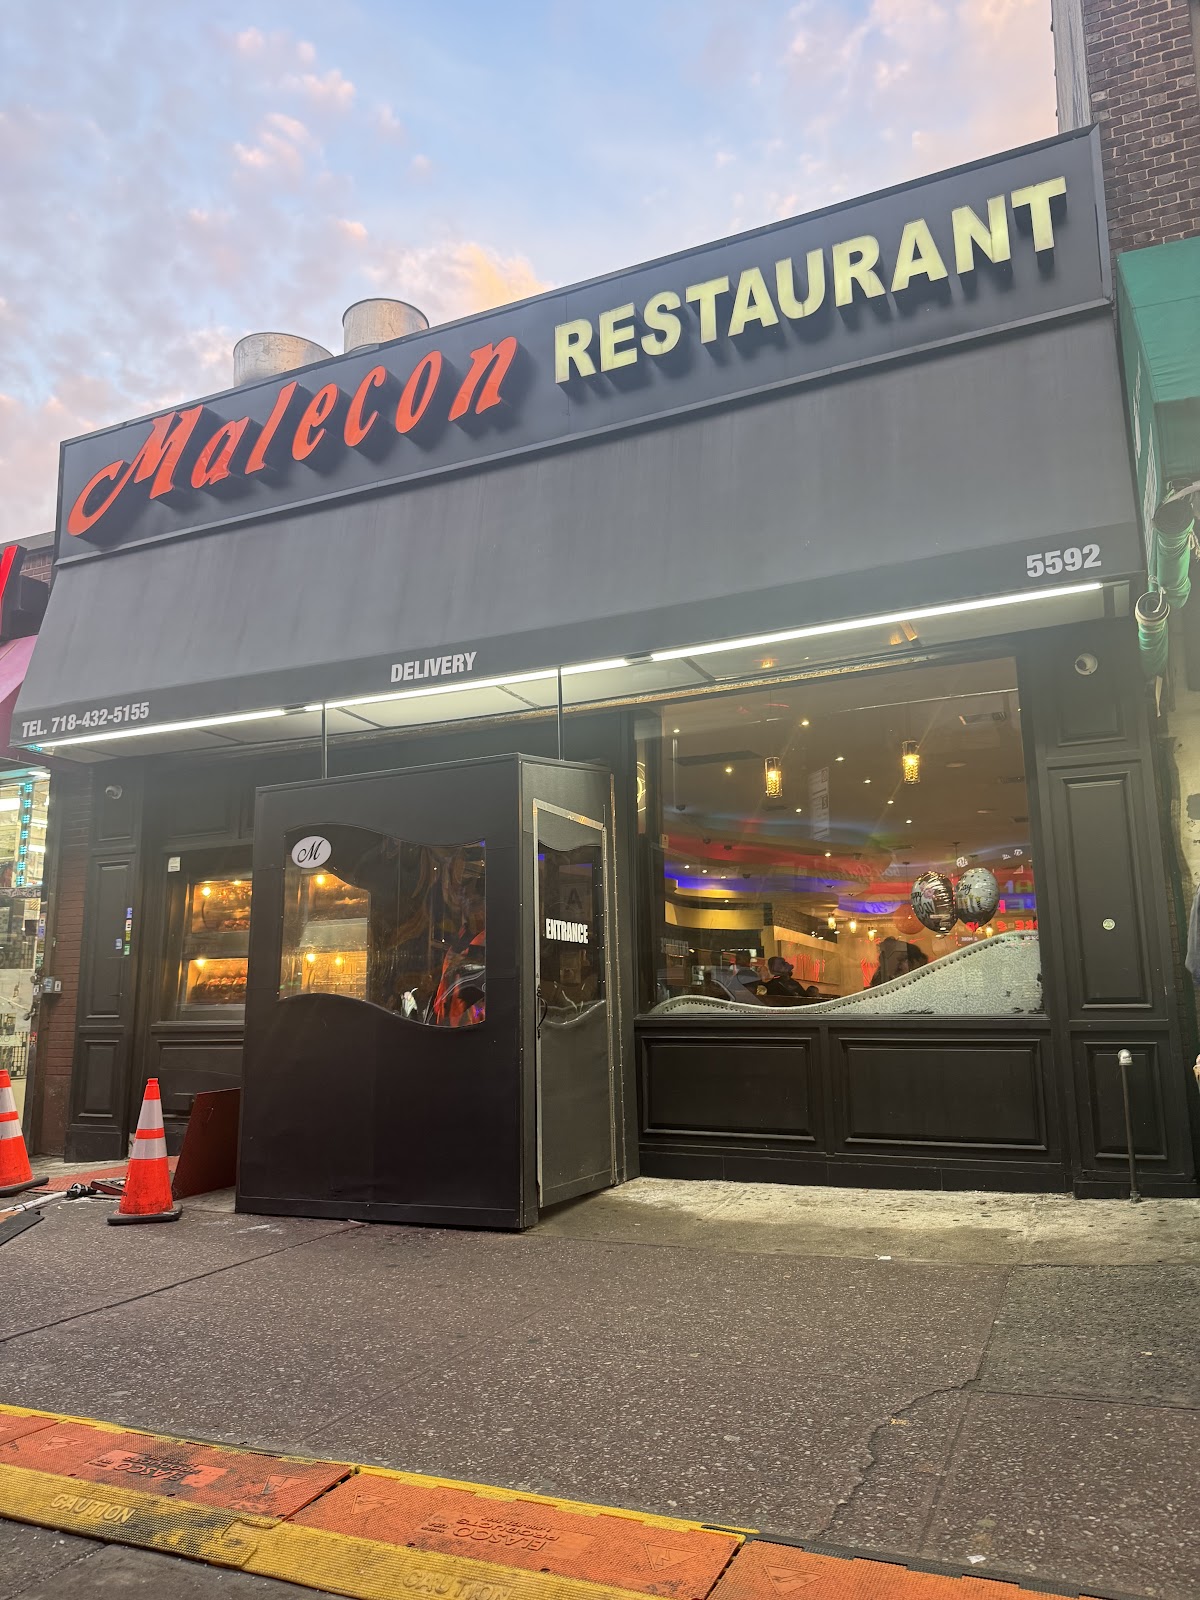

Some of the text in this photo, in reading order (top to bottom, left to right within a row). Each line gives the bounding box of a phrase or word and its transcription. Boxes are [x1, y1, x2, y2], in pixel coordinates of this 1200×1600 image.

[67, 176, 1067, 536] Malecon RESTAURANT
[1026, 543, 1102, 578] 5592
[390, 651, 477, 683] DELIVERY
[22, 701, 150, 738] TEL. 718-432-5155
[297, 839, 325, 864] M
[545, 918, 589, 944] ENTRANCE
[50, 1493, 137, 1524] CAUTION
[452, 1527, 547, 1552] ELASCO
[456, 1518, 560, 1542] PRODUCTS
[403, 1568, 514, 1600] CAUTION
